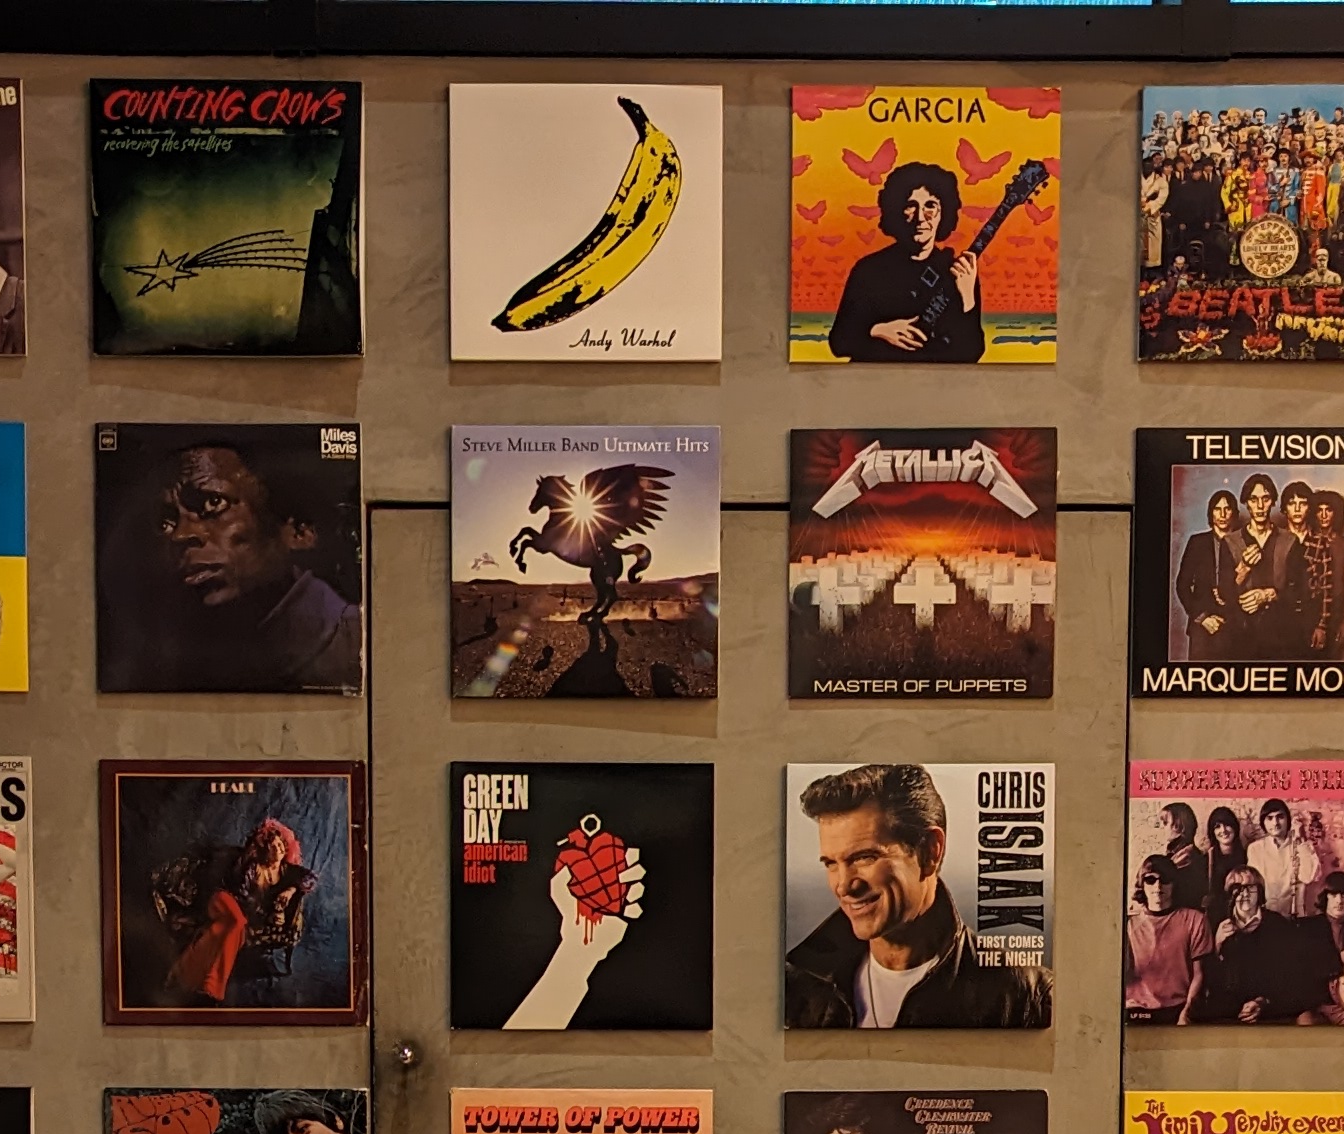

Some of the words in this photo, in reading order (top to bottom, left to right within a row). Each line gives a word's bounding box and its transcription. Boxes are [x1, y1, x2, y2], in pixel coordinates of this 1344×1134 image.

[103, 85, 246, 124] COUNTING
[250, 87, 347, 125] CROWS
[868, 97, 986, 123] GARCIA
[103, 137, 159, 157] recovering
[161, 131, 179, 152] the
[182, 135, 233, 152] satellites
[569, 328, 612, 351] Andy
[621, 329, 677, 348] Warhol
[321, 428, 356, 441] Miles
[321, 441, 357, 454] Davis
[812, 440, 1038, 518] METALLICA
[814, 680, 898, 693] MASTER
[903, 680, 929, 693] OF
[935, 679, 1027, 692] PUPPETS
[1143, 667, 1287, 692] MARQUEE
[211, 782, 255, 793] PEARL
[978, 771, 1045, 809] CHRIS
[1139, 769, 1291, 791] SURREALISTIC
[463, 774, 528, 810] GREEN
[463, 809, 503, 843] DAY
[463, 843, 528, 861] american
[463, 861, 496, 884] idiot
[978, 810, 1044, 932] ISAAK
[977, 935, 1006, 948] FIRST
[1008, 935, 1044, 948] COMES
[977, 951, 1001, 967] THE
[1005, 951, 1044, 967] NIGHT
[1145, 1099, 1165, 1114] THE
[464, 1105, 559, 1134] TOWER
[565, 1105, 601, 1134] OF
[604, 1106, 700, 1134] POWER
